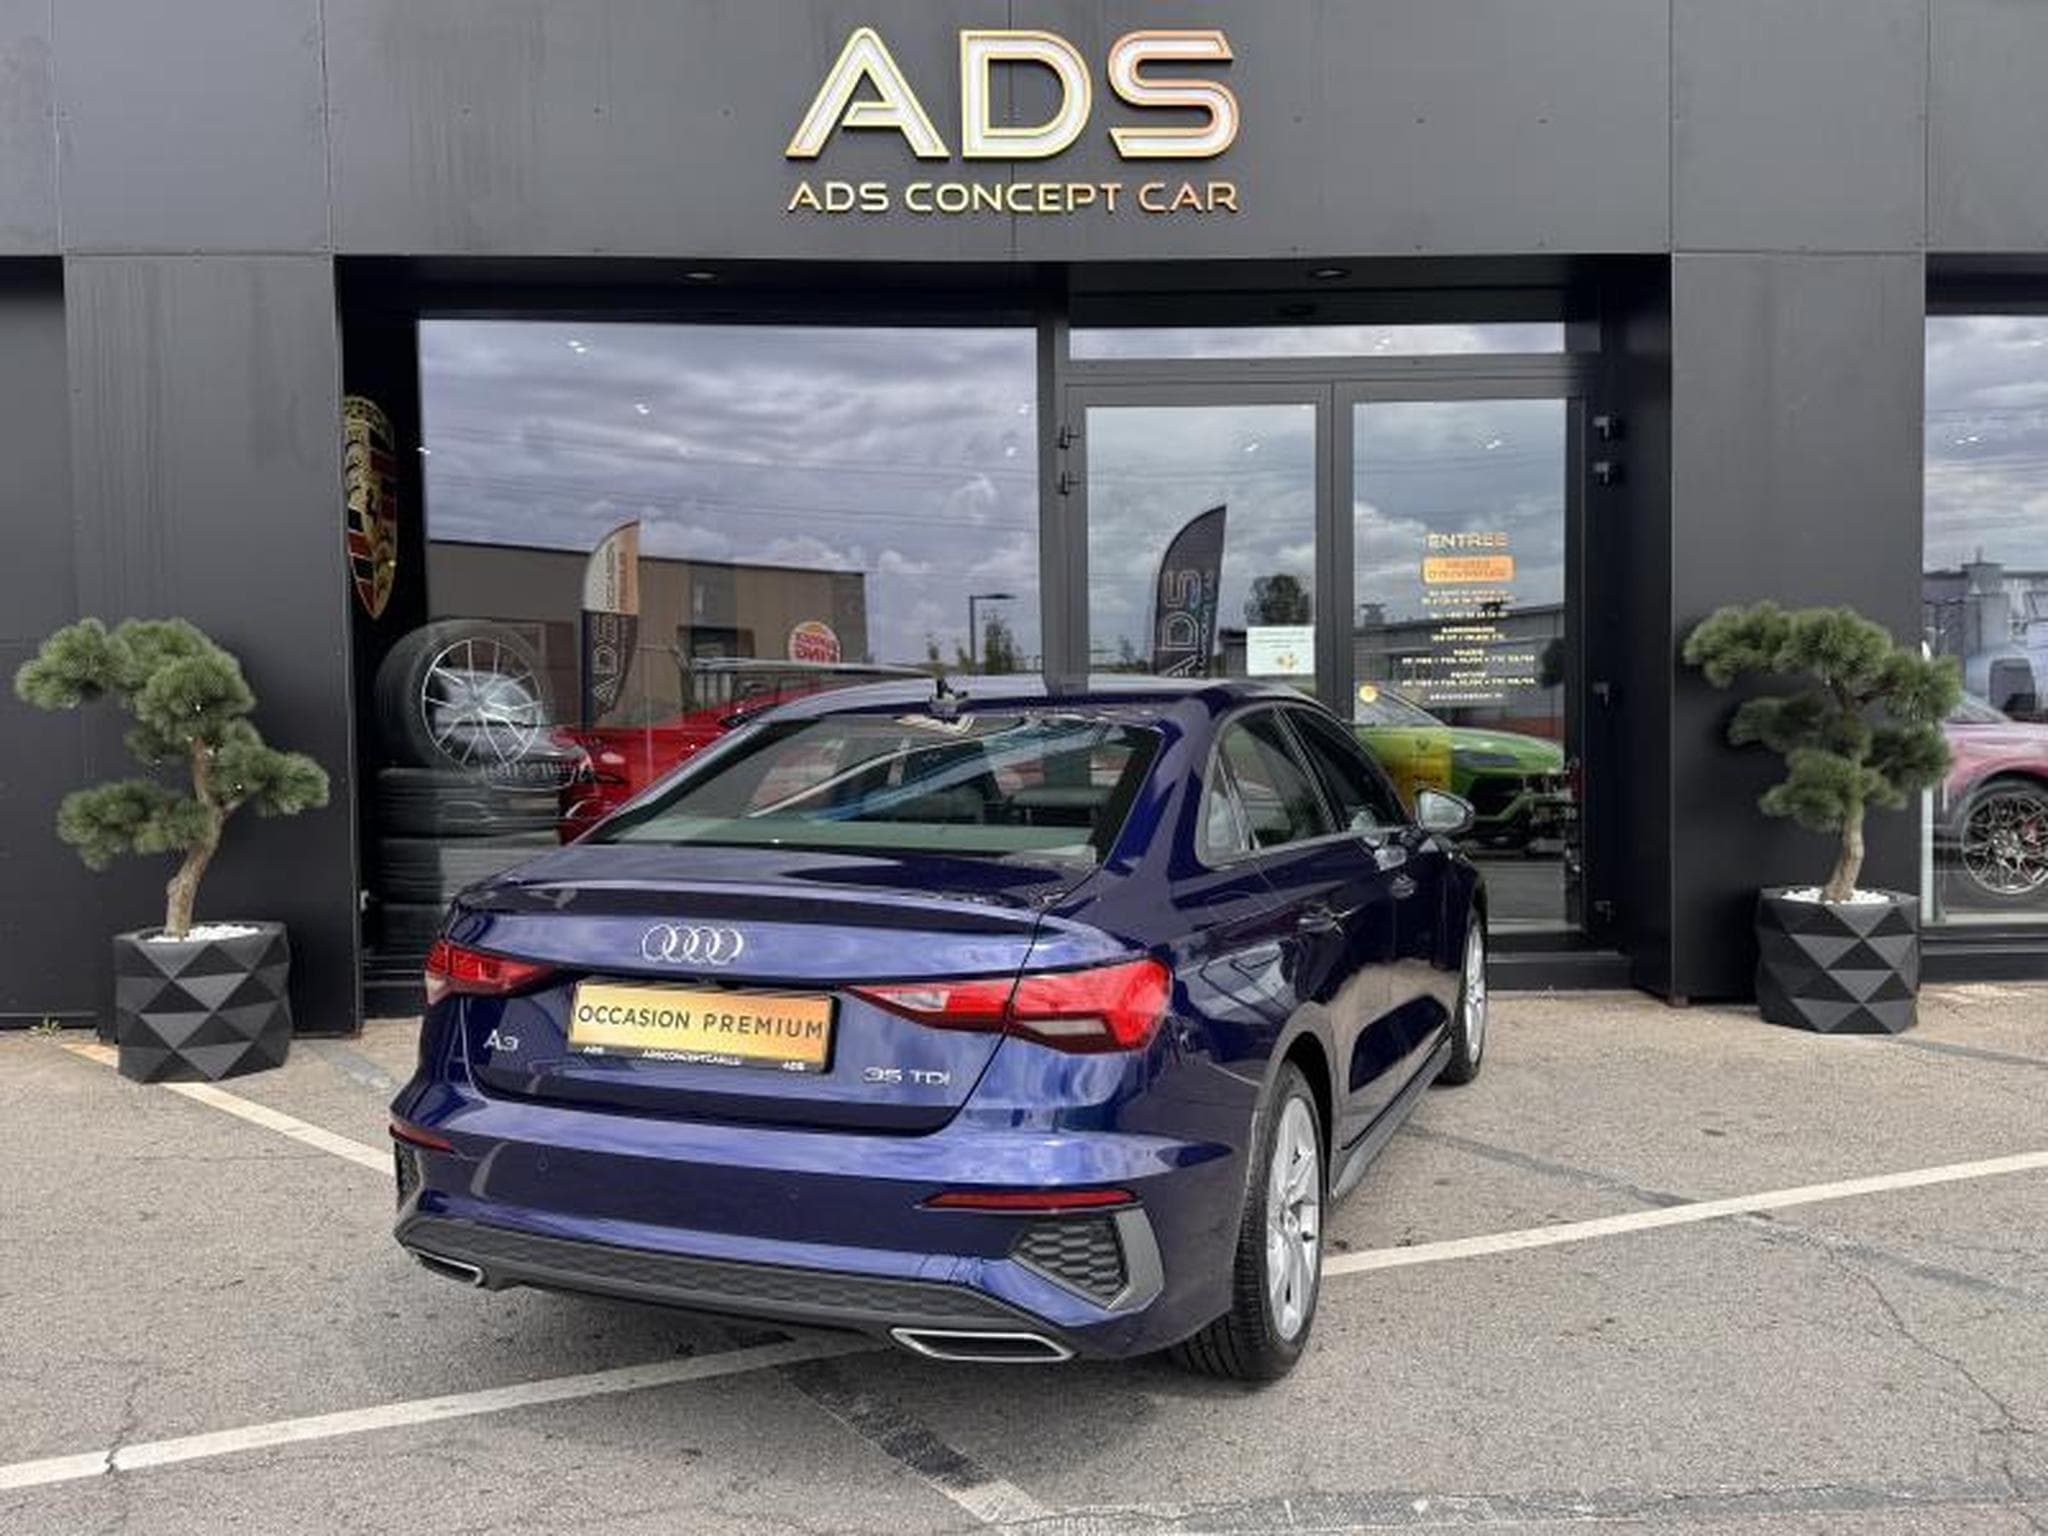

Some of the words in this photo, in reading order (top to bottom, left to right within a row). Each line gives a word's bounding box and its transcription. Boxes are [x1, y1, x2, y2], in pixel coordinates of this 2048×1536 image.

[785, 27, 1240, 159] ADS
[787, 182, 889, 212] ADS
[905, 182, 1121, 212] CONCEPT
[1139, 182, 1238, 212] CAR
[577, 1004, 691, 1030] OCCASION
[703, 1013, 824, 1039] PREMIUM
[483, 1029, 519, 1052] A3
[863, 1066, 903, 1084] 35
[909, 1069, 951, 1086] TDI
